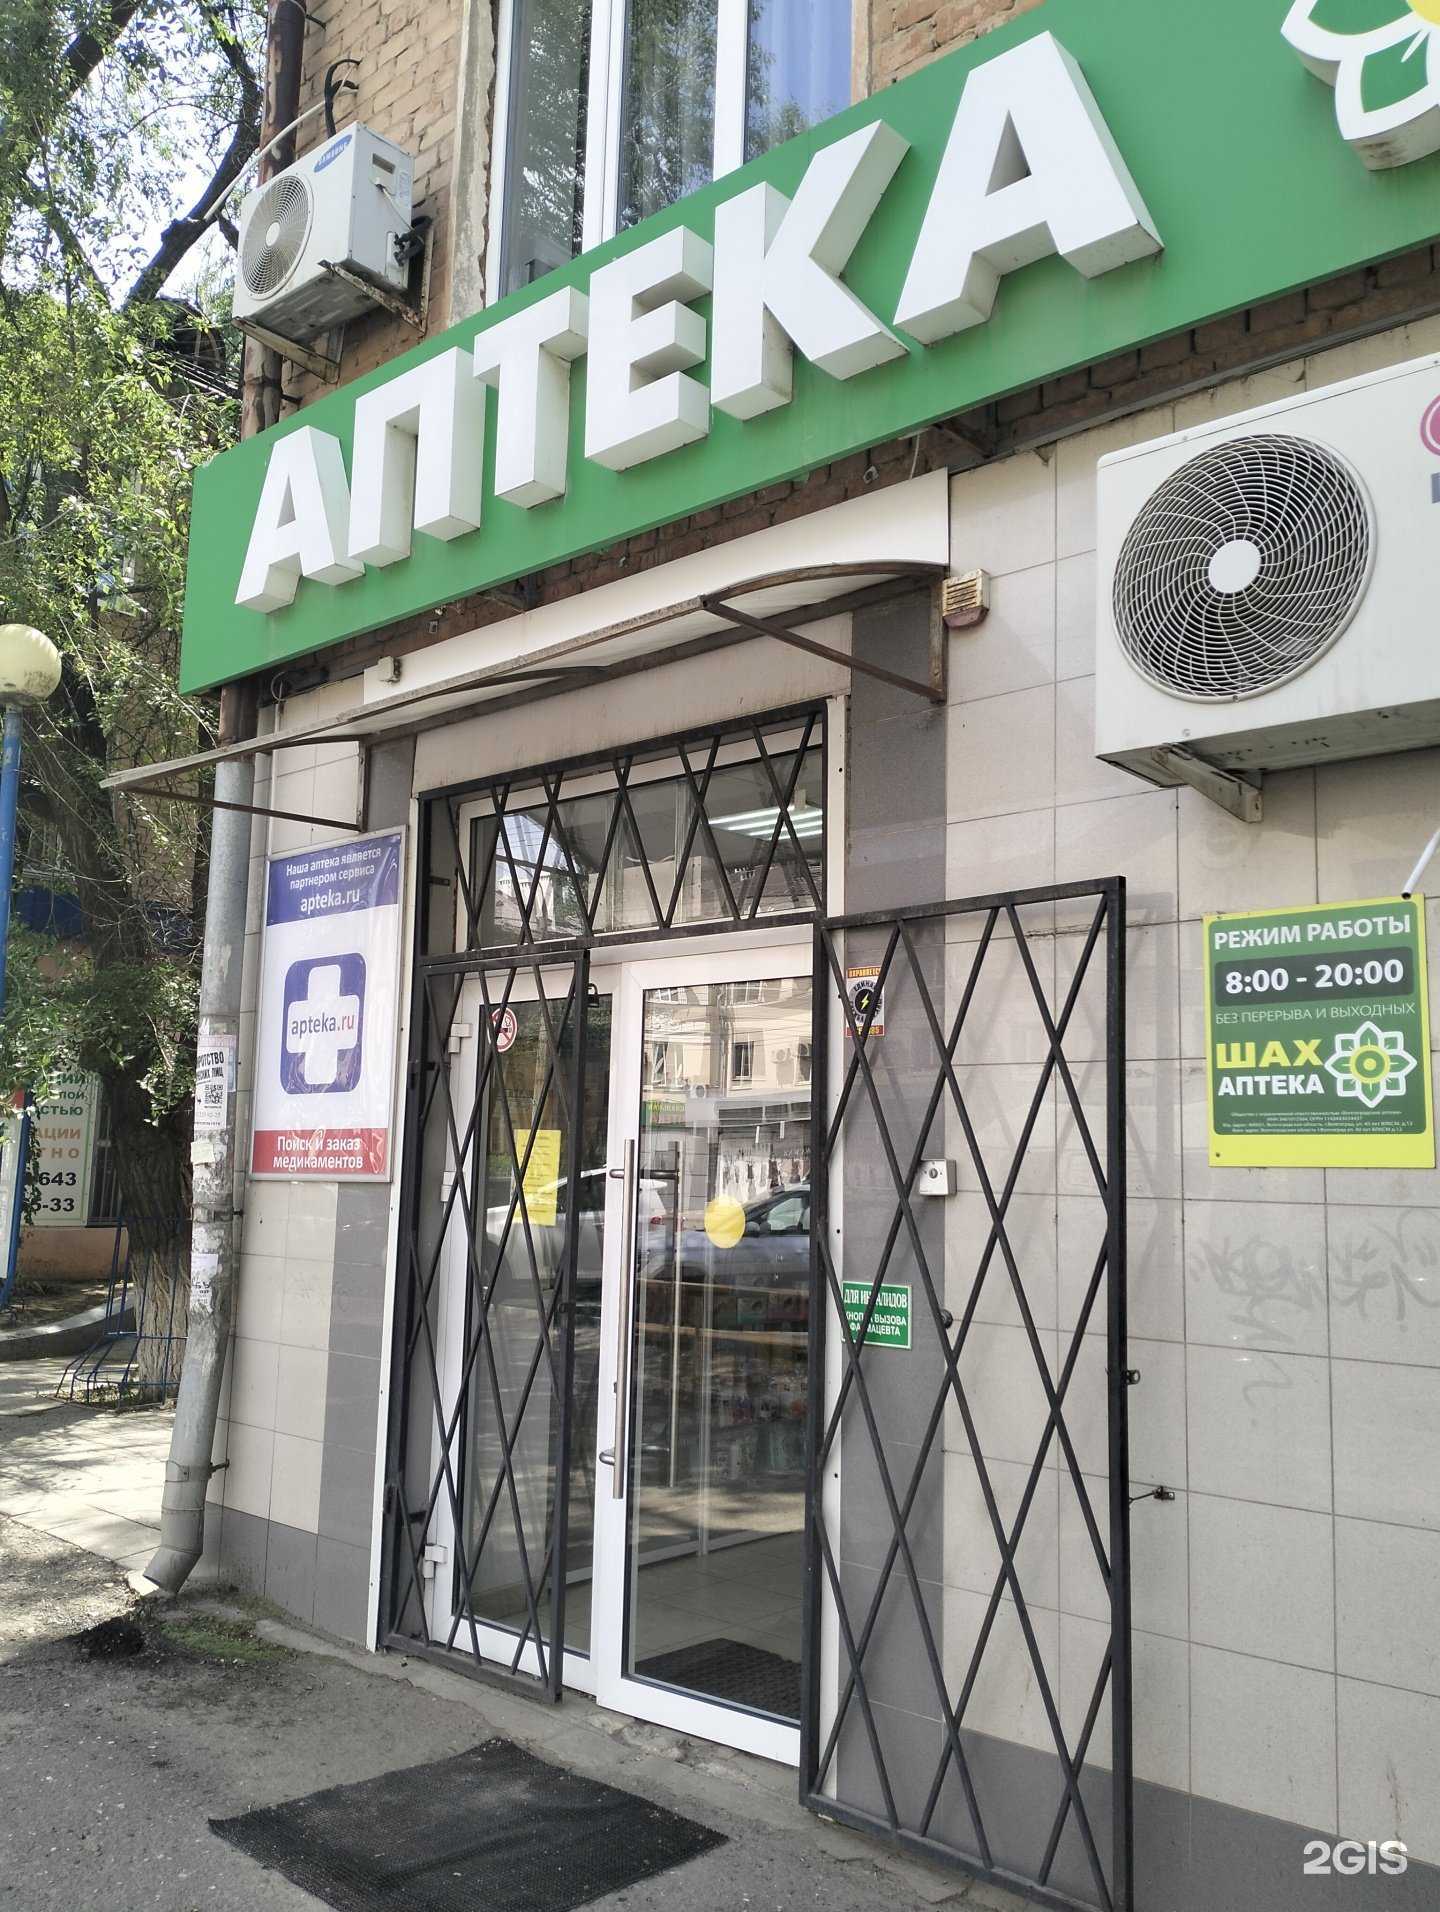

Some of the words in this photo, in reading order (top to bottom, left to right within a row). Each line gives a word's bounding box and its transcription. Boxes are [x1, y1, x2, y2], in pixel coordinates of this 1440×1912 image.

[235, 30, 1163, 612] АПТЕКА
[286, 863, 309, 877] Наша
[310, 856, 340, 872] аптека
[341, 847, 381, 864] является
[290, 872, 337, 891] партнером
[338, 864, 375, 881] сервиса
[300, 888, 360, 915] apteka.ru
[1214, 925, 1301, 950] РЕЖИМ
[1307, 914, 1411, 941] РАБОТЫ
[1225, 968, 1289, 994] 8:00
[1315, 959, 1404, 989] 20:00
[291, 1011, 355, 1039] apteka.ru
[1215, 1011, 1240, 1025] БЕЗ
[1241, 1007, 1313, 1024] ПЕРЕРЫВА
[1316, 1008, 1327, 1019] И
[1330, 1002, 1416, 1019] ВЫХОДНЫХ
[1216, 1039, 1324, 1069] ШАХ
[1217, 1074, 1325, 1096] АПТЕКА
[277, 1136, 311, 1152] Поиск
[315, 1138, 323, 1151] и
[326, 1138, 361, 1151] заказ
[273, 1156, 364, 1171] медикаментов
[844, 1289, 859, 1304] ДЛЯ
[861, 1290, 908, 1309] ИНАЛИДОВ
[850, 1322, 901, 1337] ФАМАЦЕВТА
[874, 1314, 907, 1326] ВЫЗОВА
